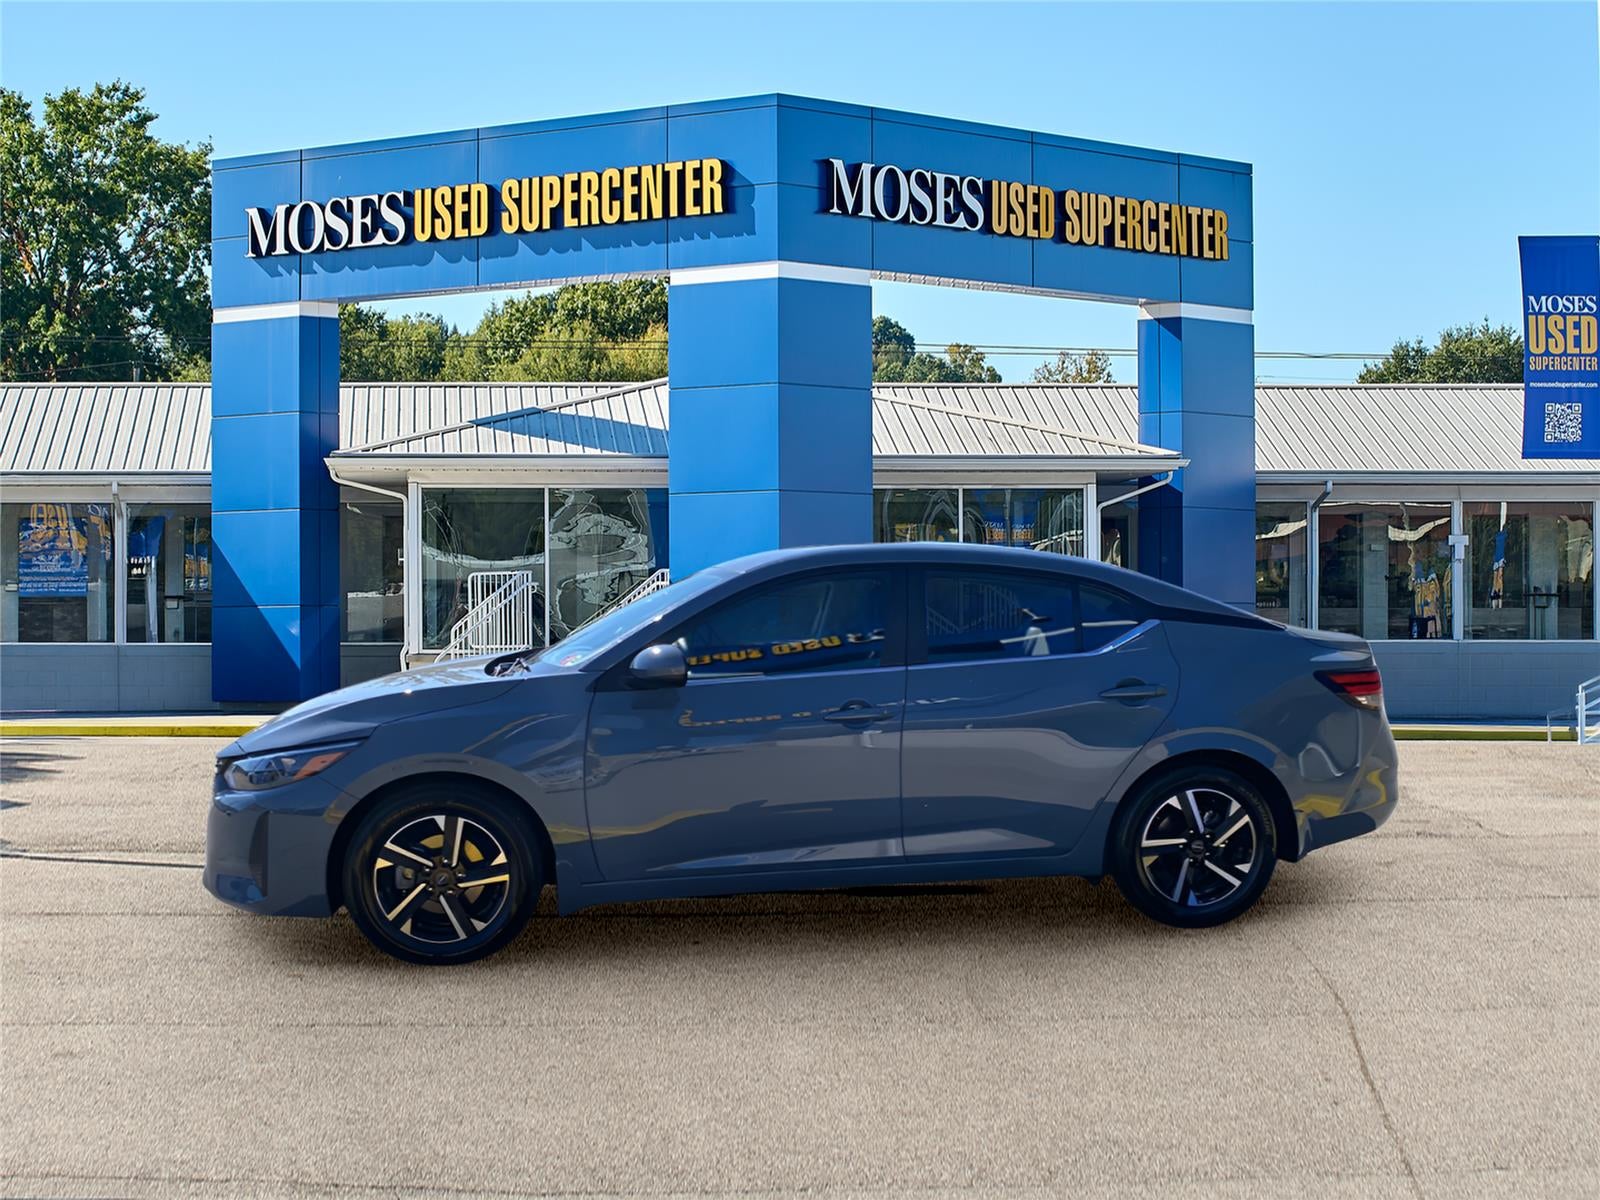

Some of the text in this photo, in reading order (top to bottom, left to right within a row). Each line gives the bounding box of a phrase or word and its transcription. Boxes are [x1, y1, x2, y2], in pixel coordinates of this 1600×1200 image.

[245, 157, 724, 258] MOSES USED SUPERCENTER
[828, 157, 1229, 261] MOSES USED SUPERCENTER
[1528, 295, 1597, 314] MOSES
[1528, 315, 1598, 355] USED
[1529, 356, 1598, 371] SUPERCENTER
